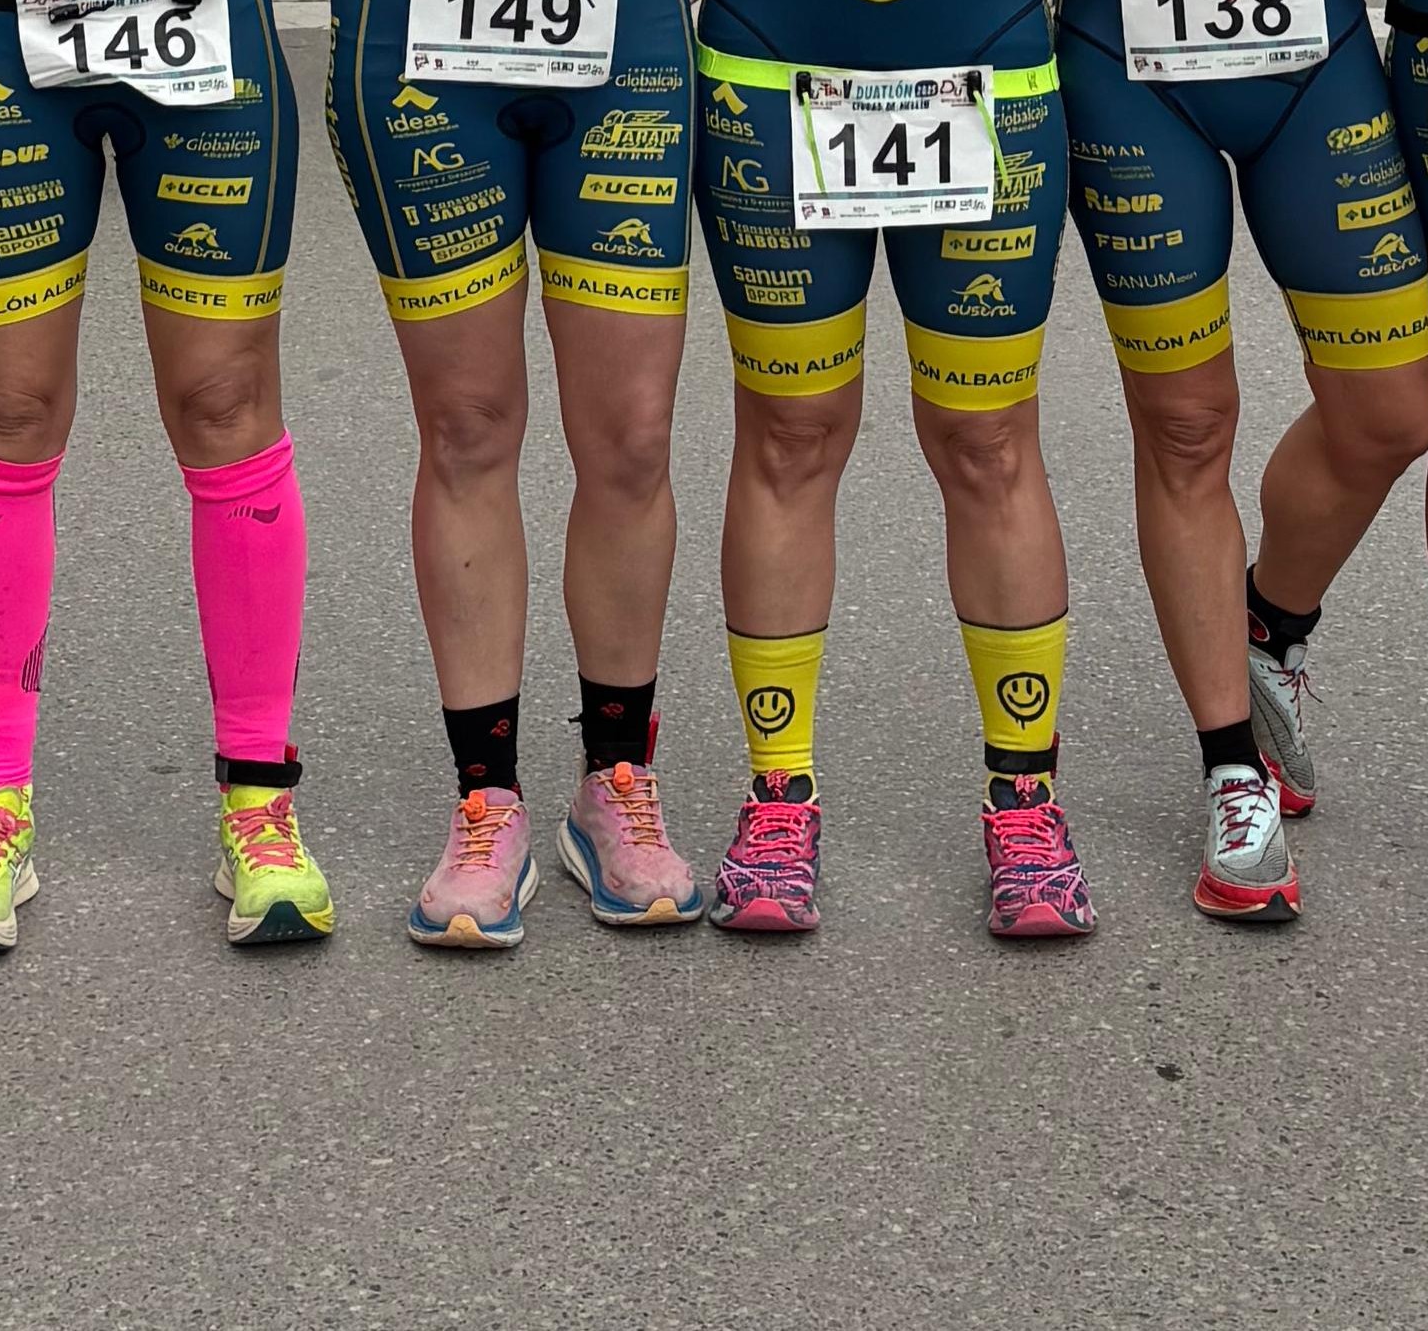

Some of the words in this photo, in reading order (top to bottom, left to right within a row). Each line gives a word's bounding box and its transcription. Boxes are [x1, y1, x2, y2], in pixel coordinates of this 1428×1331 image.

[58, 7, 197, 74] 146
[856, 80, 913, 100] DUATLÓN
[386, 110, 450, 133] ideas
[705, 111, 754, 138] ideas
[411, 142, 466, 176] AG
[828, 120, 952, 187] 141
[721, 155, 770, 193] AG
[177, 182, 248, 198] UCLM
[603, 182, 674, 197] UCLM
[415, 214, 504, 251] sanum
[964, 235, 1033, 252] UCLM
[436, 235, 493, 261] SPORT
[733, 266, 813, 286] sanum
[1106, 271, 1176, 290] SANUM
[398, 273, 494, 310] TRIATLÓN
[578, 278, 681, 301] ALBACETE
[945, 363, 1038, 387] ALBACETE
